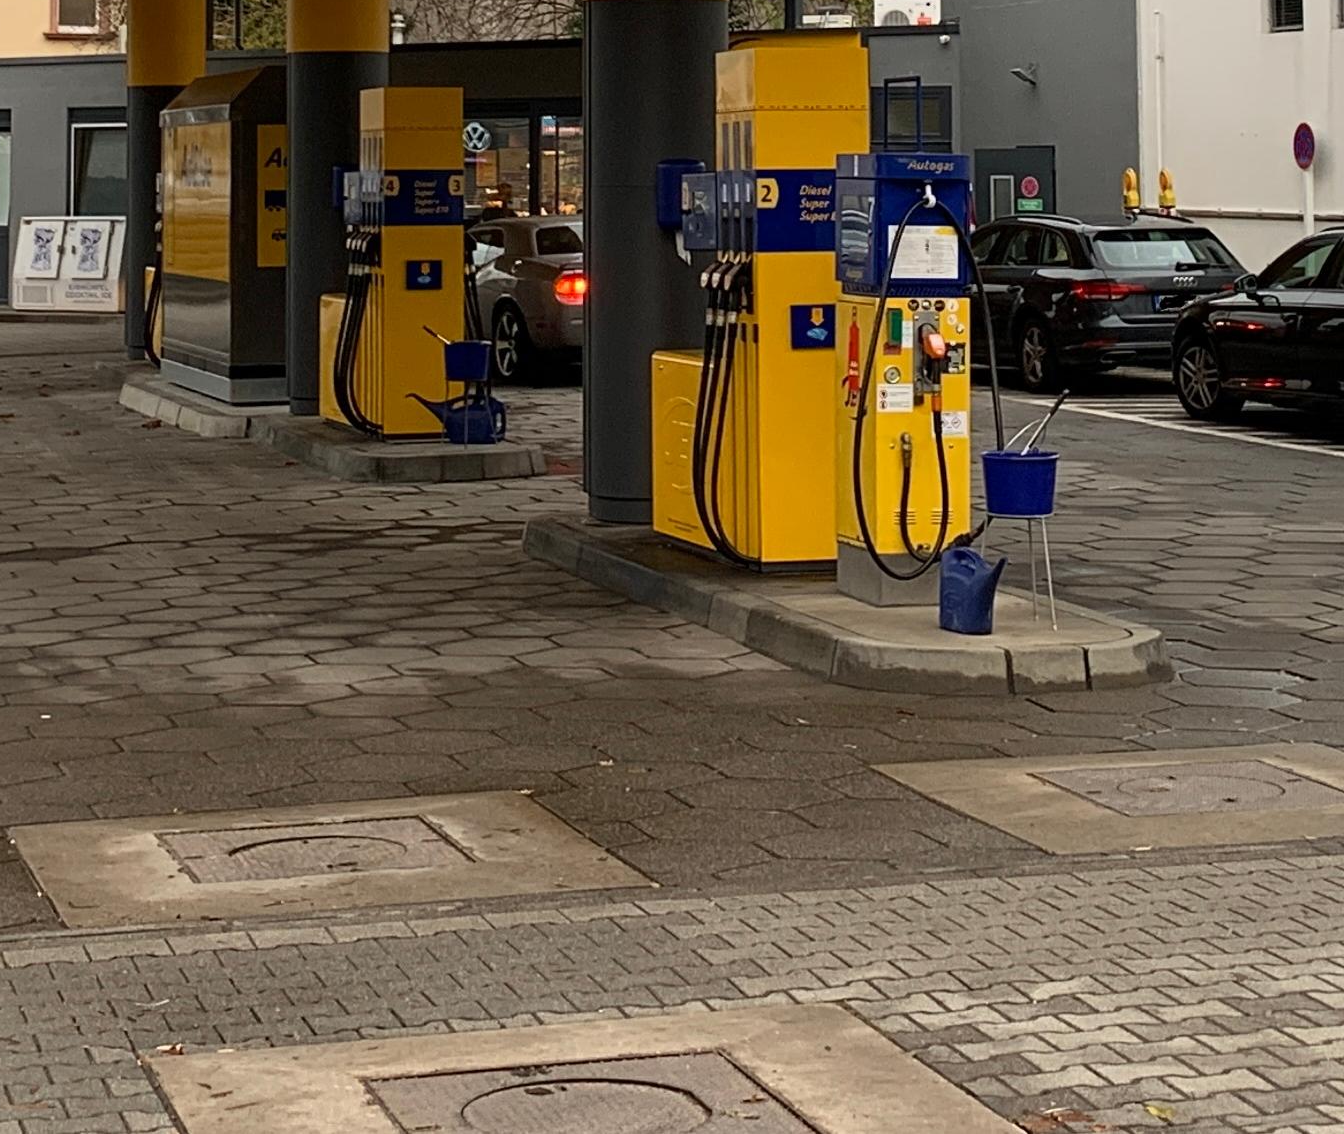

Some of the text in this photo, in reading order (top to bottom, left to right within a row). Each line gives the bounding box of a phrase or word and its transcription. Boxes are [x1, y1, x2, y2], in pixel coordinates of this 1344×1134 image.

[907, 160, 955, 174] Autogas
[761, 184, 773, 203] 2
[799, 184, 833, 196] Diesel
[799, 197, 830, 211] Super
[799, 210, 829, 224] Super
